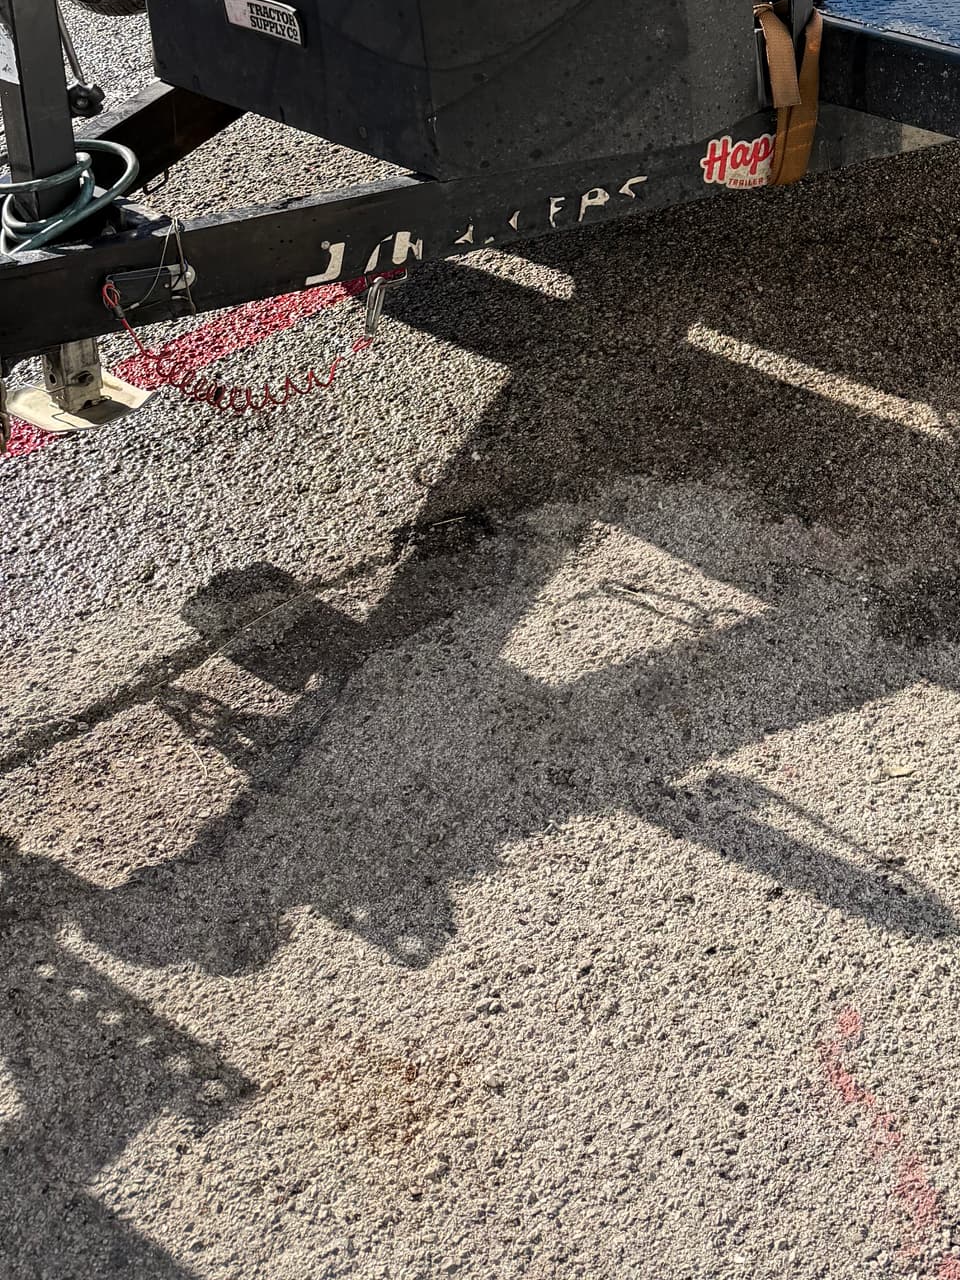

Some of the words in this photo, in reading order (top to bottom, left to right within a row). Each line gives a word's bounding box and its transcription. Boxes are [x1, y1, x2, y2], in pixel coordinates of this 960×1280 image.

[246, 1, 297, 28] TRACTOR
[249, 15, 286, 37] SUPPLY
[703, 136, 776, 181] Hap
[728, 177, 764, 187] TRAILER
